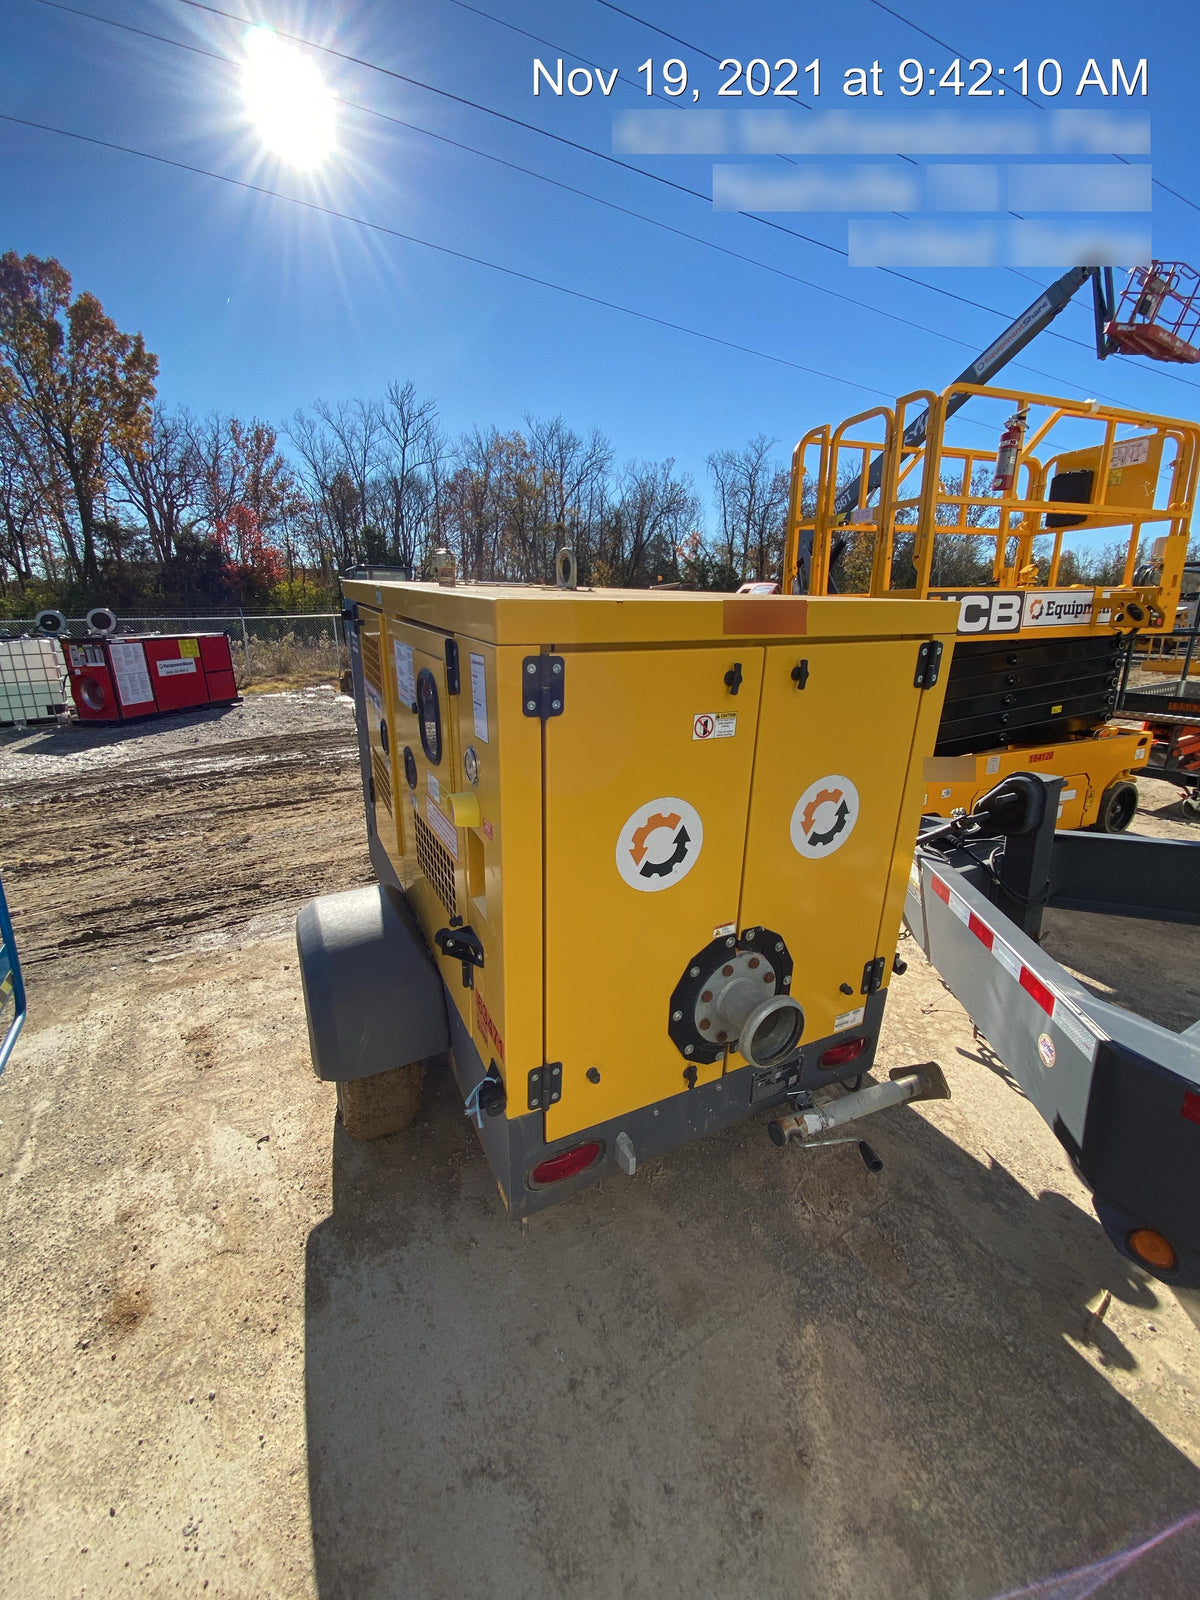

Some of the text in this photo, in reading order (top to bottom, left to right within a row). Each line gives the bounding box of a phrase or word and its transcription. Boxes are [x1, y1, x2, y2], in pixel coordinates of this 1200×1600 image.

[984, 301, 1048, 363] EquipmentShare
[834, 489, 852, 515] 86T
[947, 595, 1021, 632] CB
